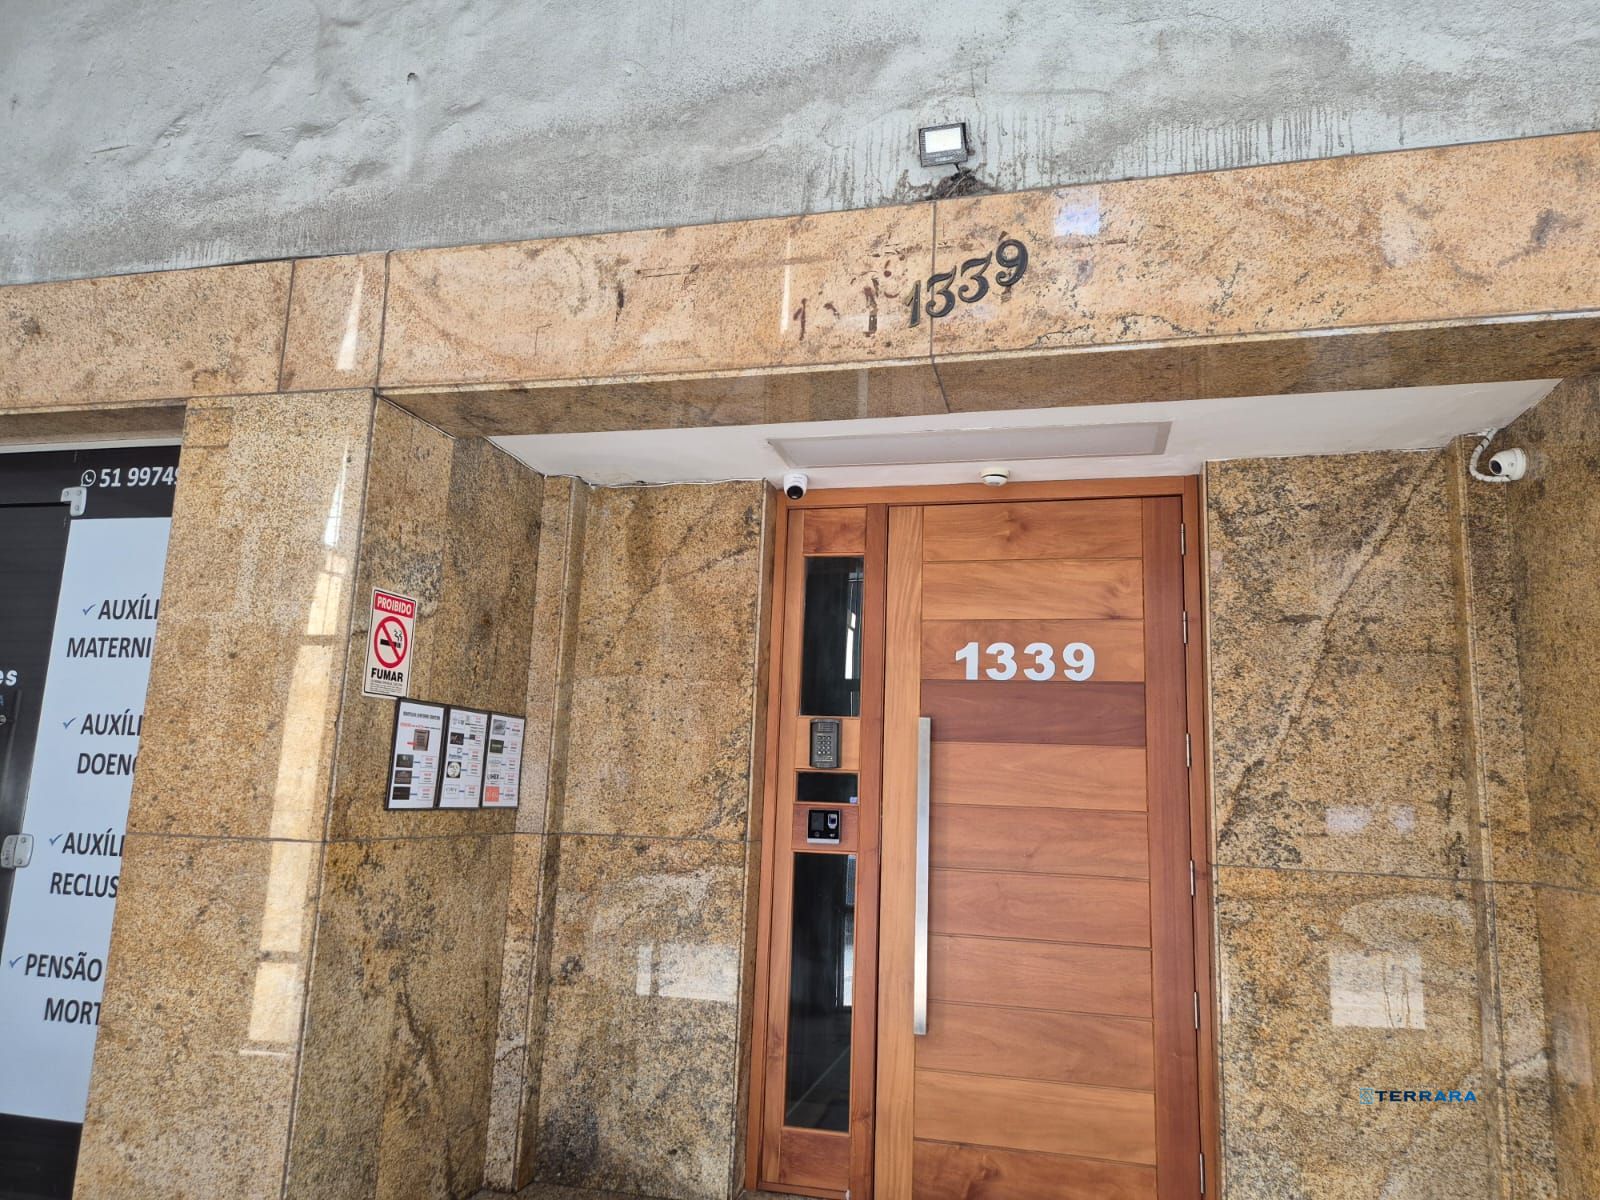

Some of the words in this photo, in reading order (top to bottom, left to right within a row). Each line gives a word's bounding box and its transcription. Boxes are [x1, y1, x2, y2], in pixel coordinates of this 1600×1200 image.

[904, 239, 1028, 328] 1339
[99, 468, 121, 487] 51
[98, 593, 159, 620] AUXÍLI
[376, 596, 412, 615] PROIBIDO
[66, 637, 152, 658] MATERNI
[955, 642, 1095, 681] 1339
[371, 668, 404, 682] FUMAR
[50, 872, 119, 898] RECLUS
[25, 952, 102, 982] PENSÃO
[44, 998, 101, 1025] MORT
